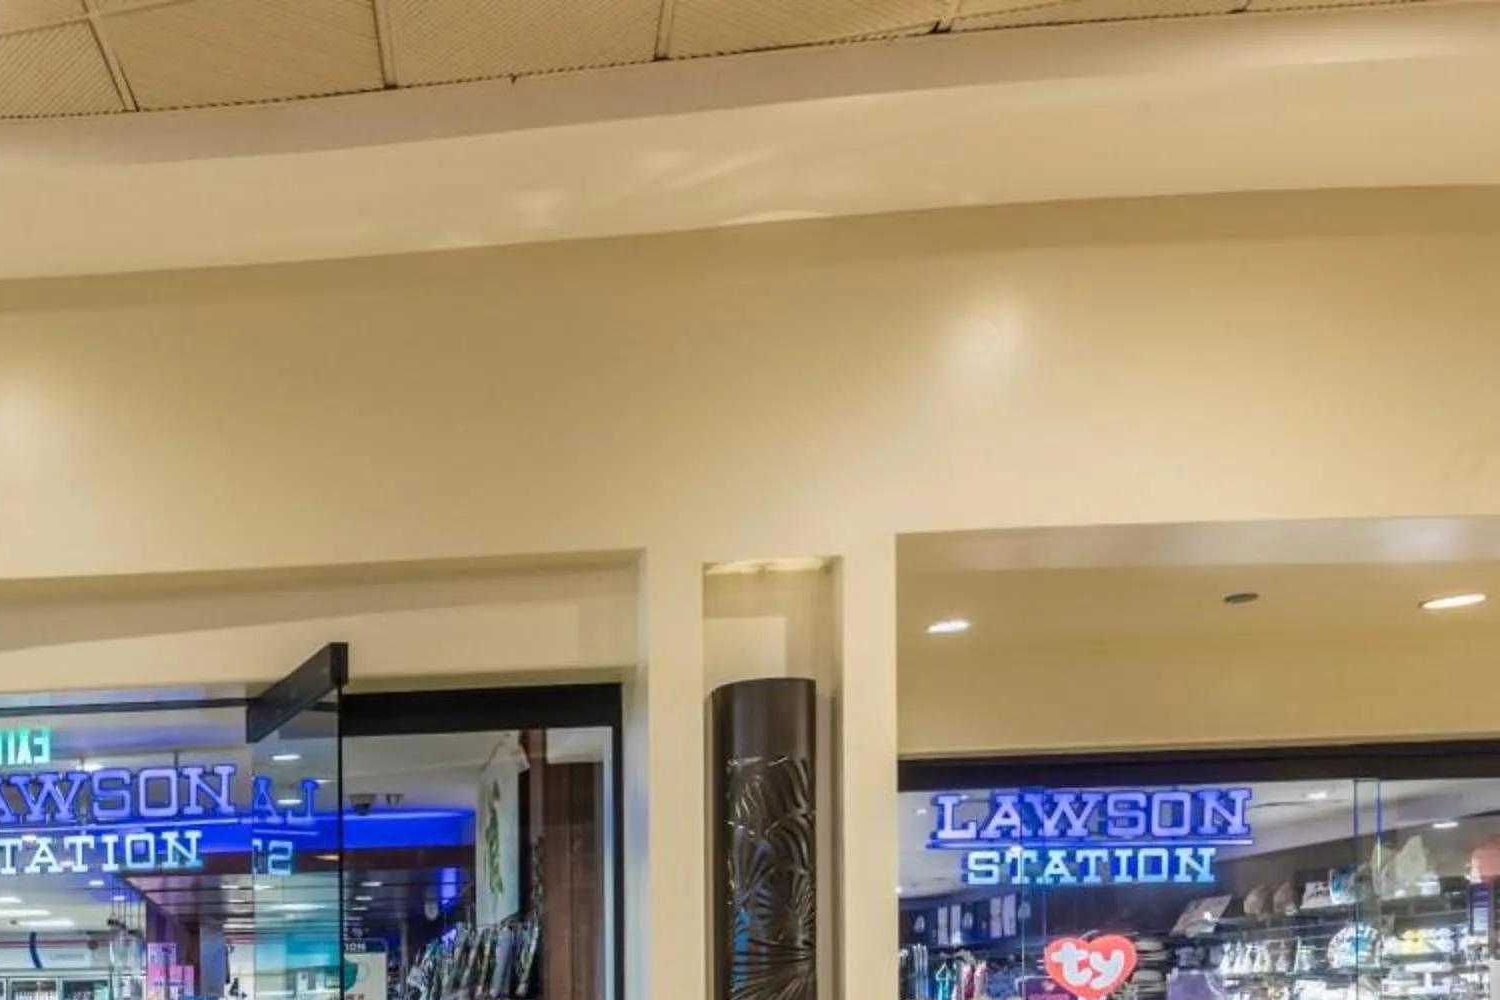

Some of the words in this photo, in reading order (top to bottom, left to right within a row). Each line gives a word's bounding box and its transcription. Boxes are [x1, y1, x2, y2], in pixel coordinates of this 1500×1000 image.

[932, 788, 1252, 839] LAWSON
[965, 847, 1217, 884] STATION
[1051, 941, 1124, 989] ty
